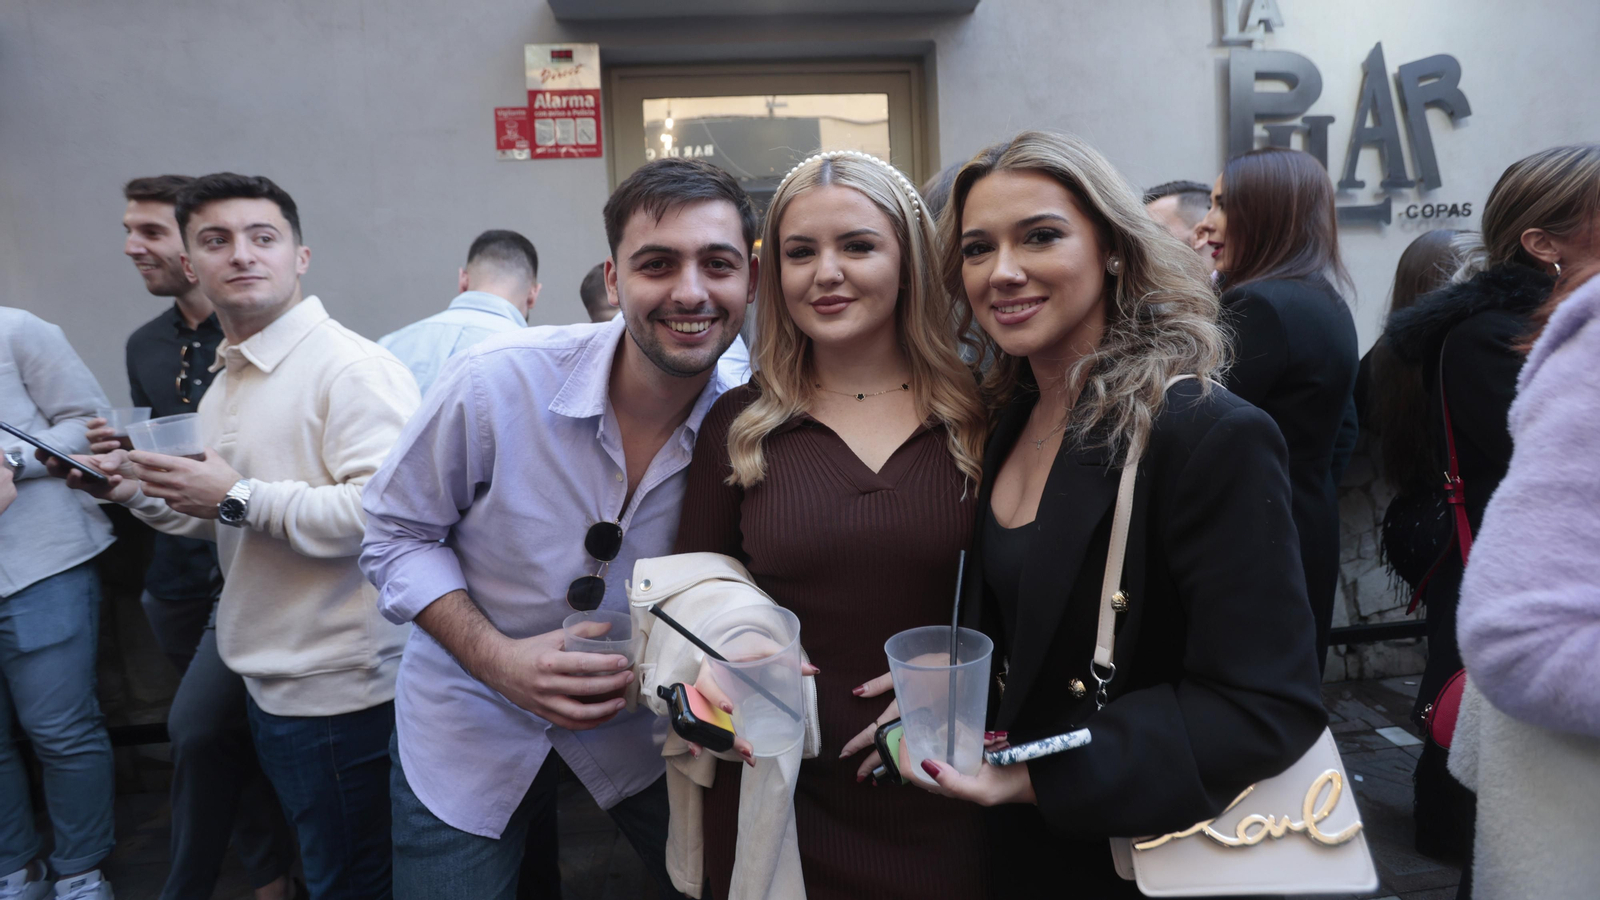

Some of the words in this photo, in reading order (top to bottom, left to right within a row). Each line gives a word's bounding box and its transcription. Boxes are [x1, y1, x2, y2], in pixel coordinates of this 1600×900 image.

[534, 92, 595, 109] Alarma
[1228, 41, 1472, 224] PLAR
[1406, 203, 1472, 219] COPAS
